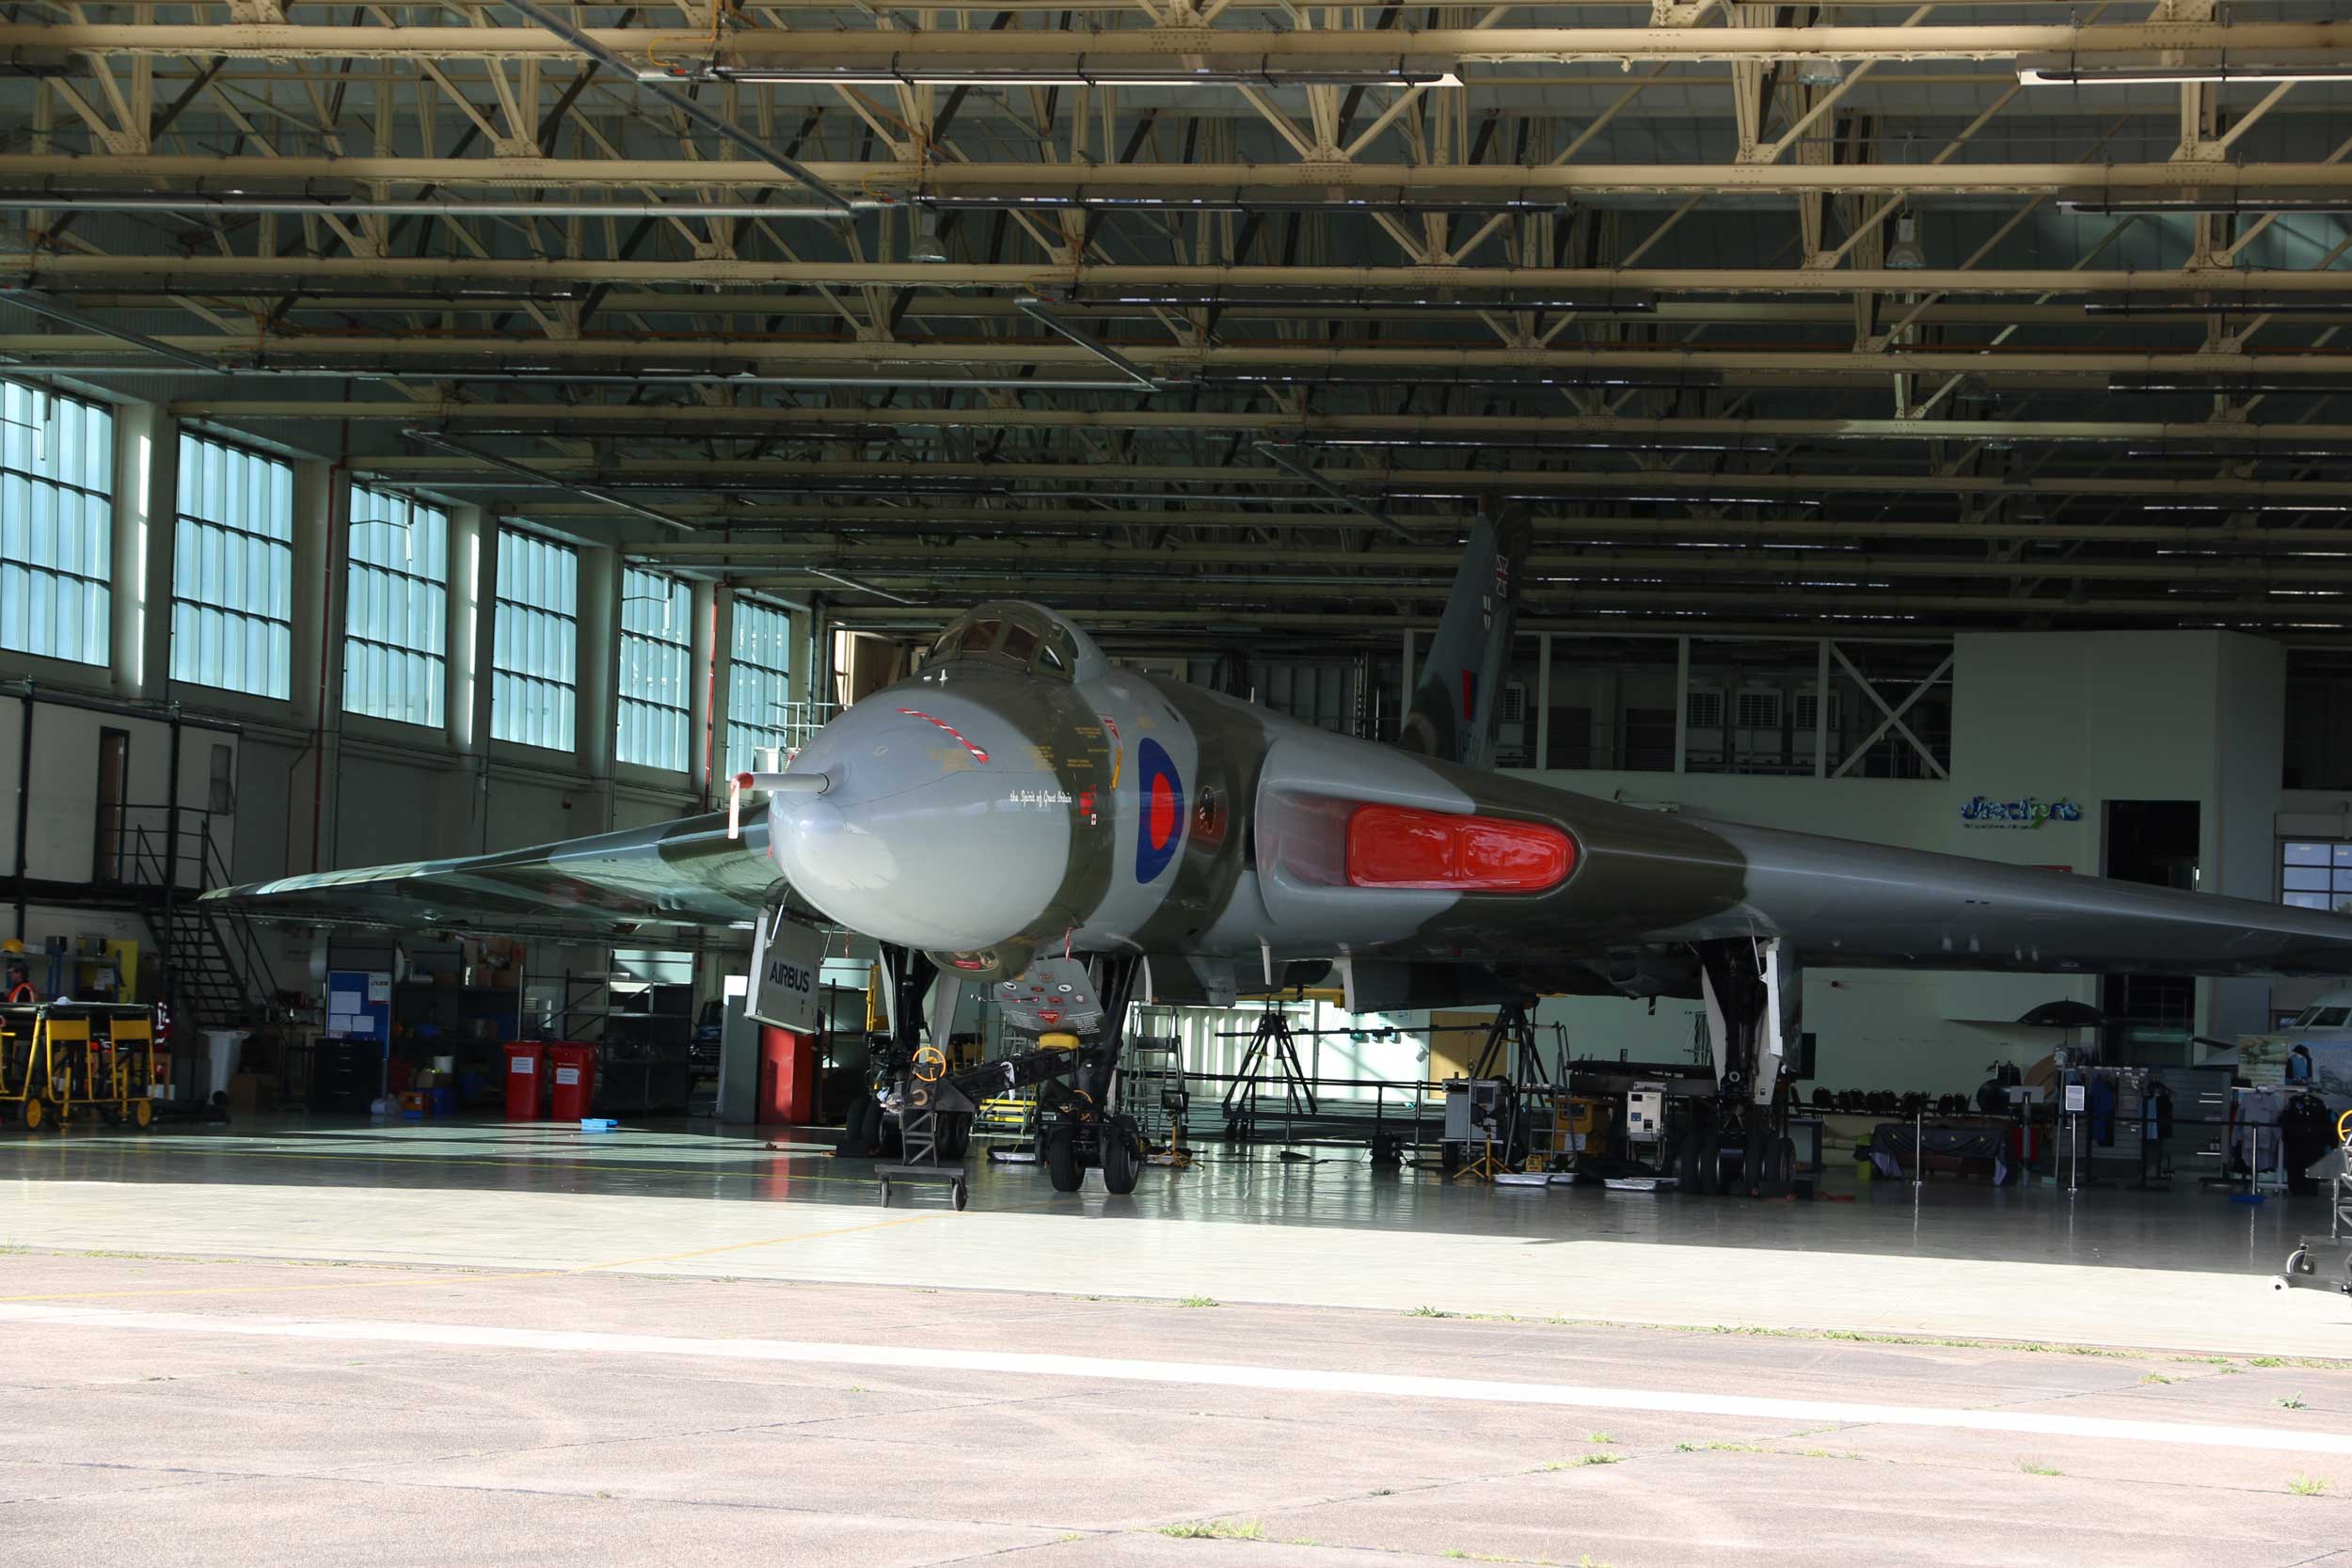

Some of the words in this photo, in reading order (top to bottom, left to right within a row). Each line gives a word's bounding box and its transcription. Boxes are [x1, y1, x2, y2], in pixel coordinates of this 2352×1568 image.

[1009, 790, 1019, 802] the
[1021, 790, 1035, 808] Spirit
[1036, 790, 1042, 808] of
[1043, 790, 1057, 808] Great
[1057, 790, 1073, 803] Britain
[770, 961, 810, 993] AIRBUS
